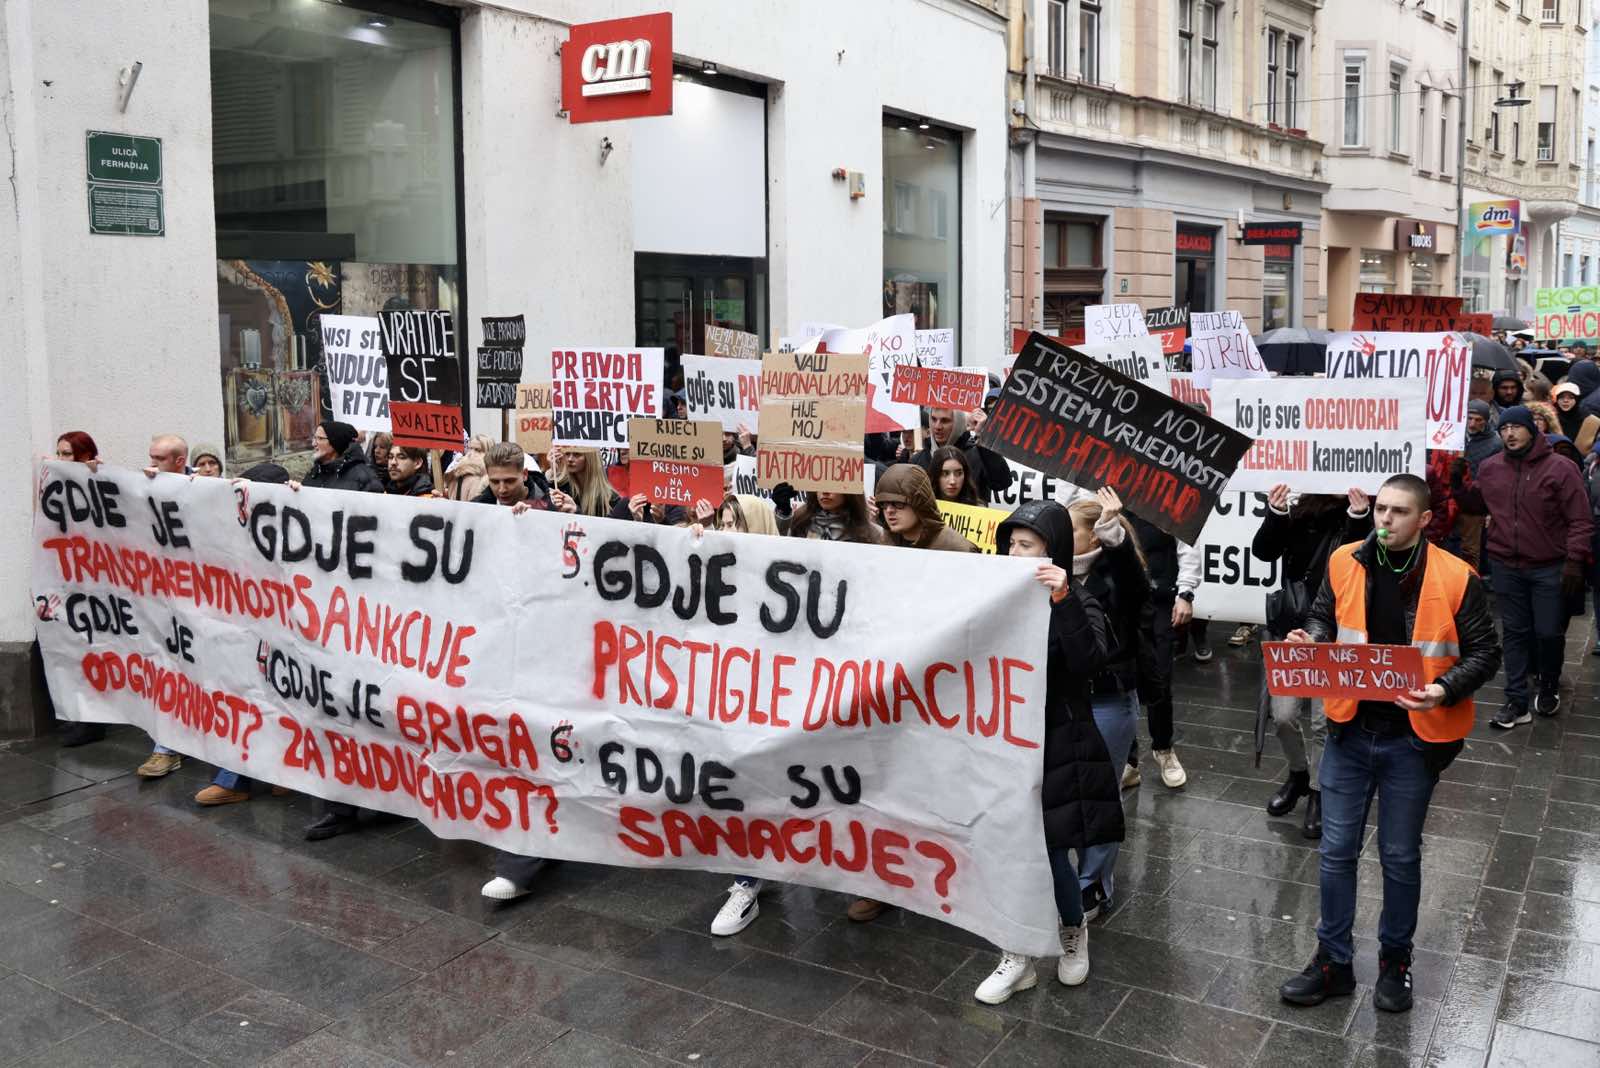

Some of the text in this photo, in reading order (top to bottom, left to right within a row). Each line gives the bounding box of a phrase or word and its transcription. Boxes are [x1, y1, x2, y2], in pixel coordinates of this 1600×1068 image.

[581, 38, 652, 83] cm
[101, 159, 149, 170] FERHADIJA
[112, 147, 138, 157] ULICA
[1483, 206, 1510, 222] dm
[1411, 234, 1432, 249] TUDORS
[1361, 294, 1416, 316] SAMO
[1536, 287, 1600, 308] EKOCI
[1147, 304, 1188, 328] ZLOČIN
[881, 335, 902, 351] KO
[400, 357, 442, 405] SE
[552, 351, 642, 381] PRAVDA
[520, 388, 552, 409] JABLA
[553, 381, 579, 409] ZA
[687, 370, 761, 414] gdje su PA
[895, 381, 917, 401] MI
[1034, 342, 1139, 414] TRAŽIMO
[1154, 409, 1226, 458] NOVI
[393, 411, 461, 435] WALTER
[1008, 368, 1101, 429] SISTEM
[1103, 414, 1229, 496] VRIJEDNOSTI
[1236, 398, 1399, 436] ko je sve ODGOVORAN
[637, 441, 687, 460] IZGUBILE
[691, 446, 705, 460] SU
[1312, 441, 1413, 474] kamenolom?
[654, 486, 691, 502] DJELA
[669, 478, 683, 487] NA
[41, 479, 127, 533] GDJE
[148, 496, 192, 548] JE
[251, 502, 378, 580] GDJE
[401, 514, 475, 584] SU
[561, 530, 848, 639] 5. GDJE SU
[65, 592, 139, 643] GDJE
[166, 616, 195, 663] JE
[292, 574, 477, 688] SANKCIJE
[1269, 647, 1393, 665] VLAST NAS JE
[593, 620, 1040, 749] PRISTIGLE DONACIJE
[1271, 669, 1417, 690] PUSTILA NIZ VODU
[81, 651, 262, 760] ODGOVORNOST?
[270, 650, 338, 717] GDJE
[346, 679, 385, 728] JE
[397, 695, 538, 771] BRIGA
[278, 715, 325, 779] ZA
[550, 724, 863, 811] 6. GDJE SU
[616, 806, 958, 914] SANACIJE?
